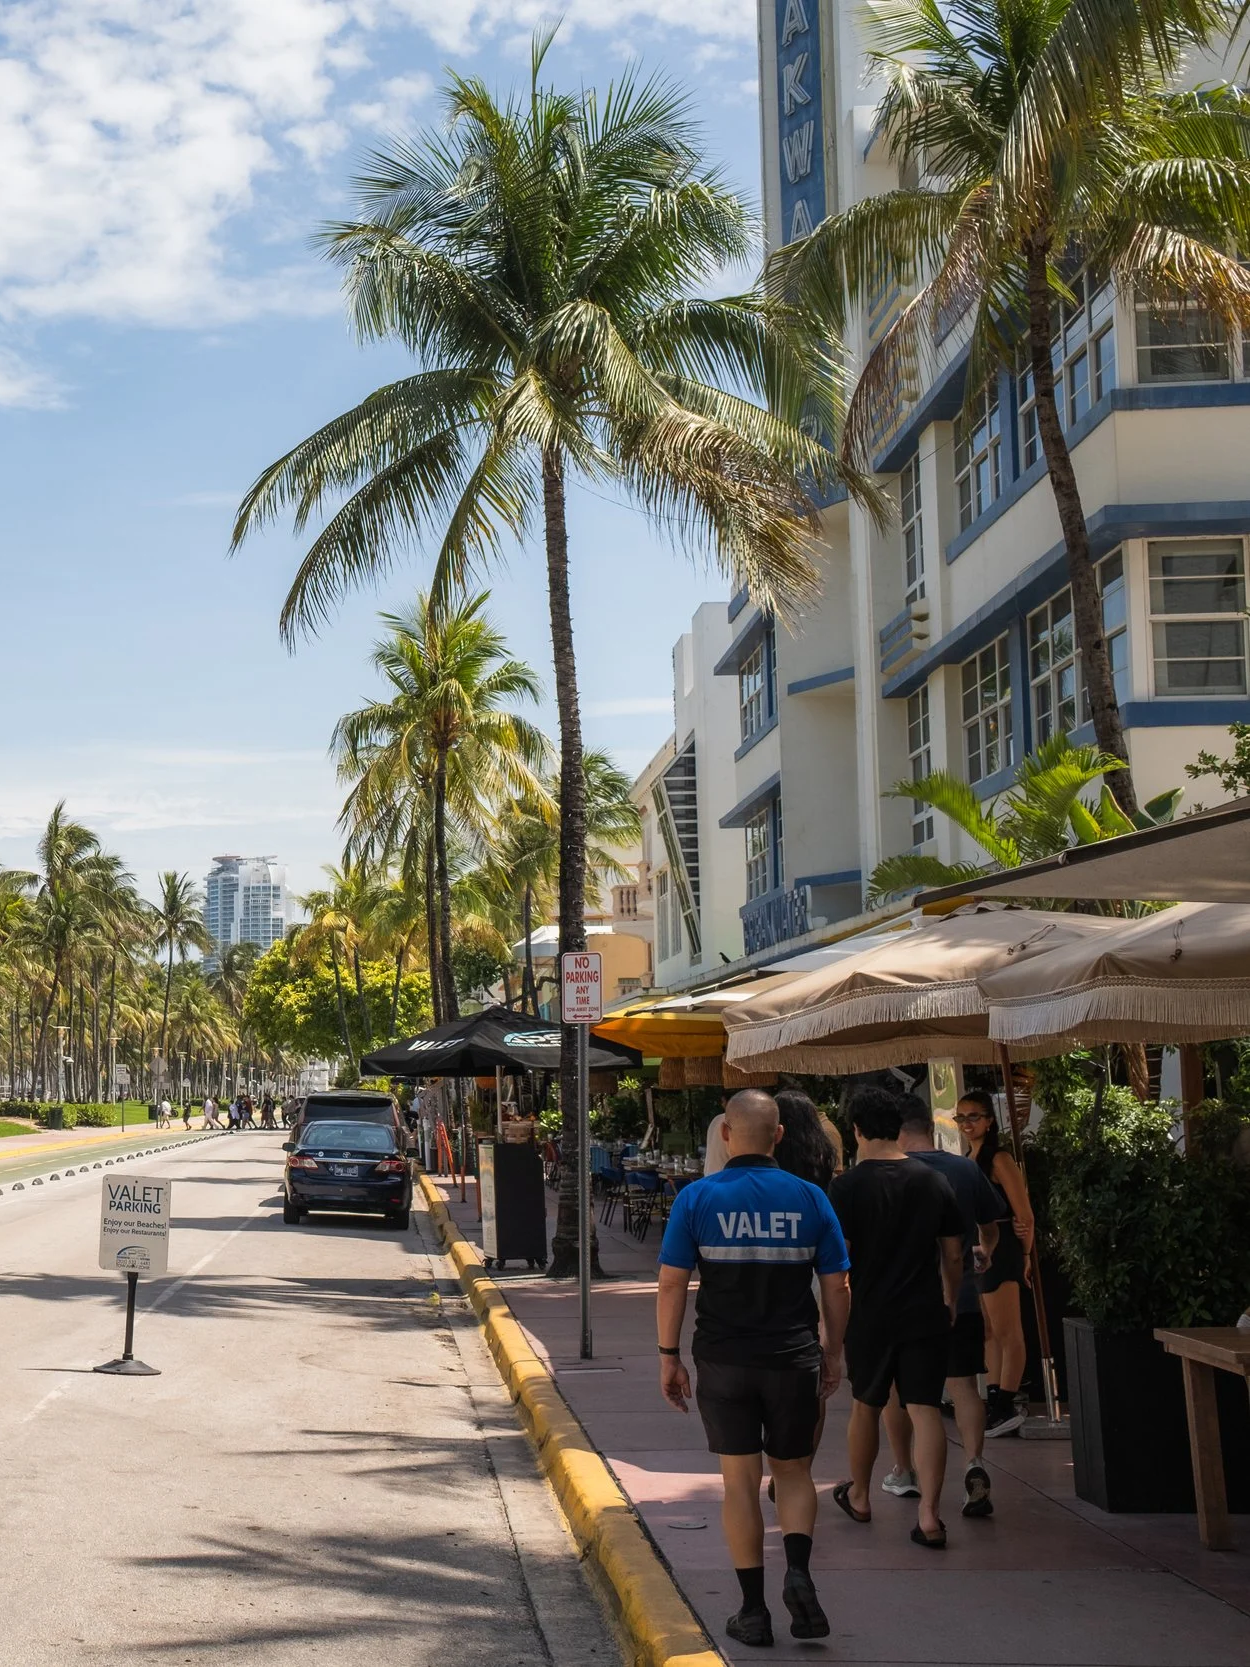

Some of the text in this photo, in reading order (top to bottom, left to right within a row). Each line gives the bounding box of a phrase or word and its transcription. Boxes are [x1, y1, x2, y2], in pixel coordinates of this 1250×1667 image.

[575, 956, 590, 969] NO
[565, 970, 599, 983] PARKING
[575, 985, 590, 994] ANY
[575, 996, 590, 1005] TIME
[407, 1038, 466, 1051] VALET
[108, 1183, 164, 1203] VALET
[109, 1200, 161, 1214] PARKING
[103, 1217, 122, 1227] Enjoy
[136, 1220, 167, 1230] Beaches!
[716, 1211, 802, 1239] VALET
[103, 1226, 119, 1235] Enjoy
[131, 1228, 167, 1237] Restaurants!
